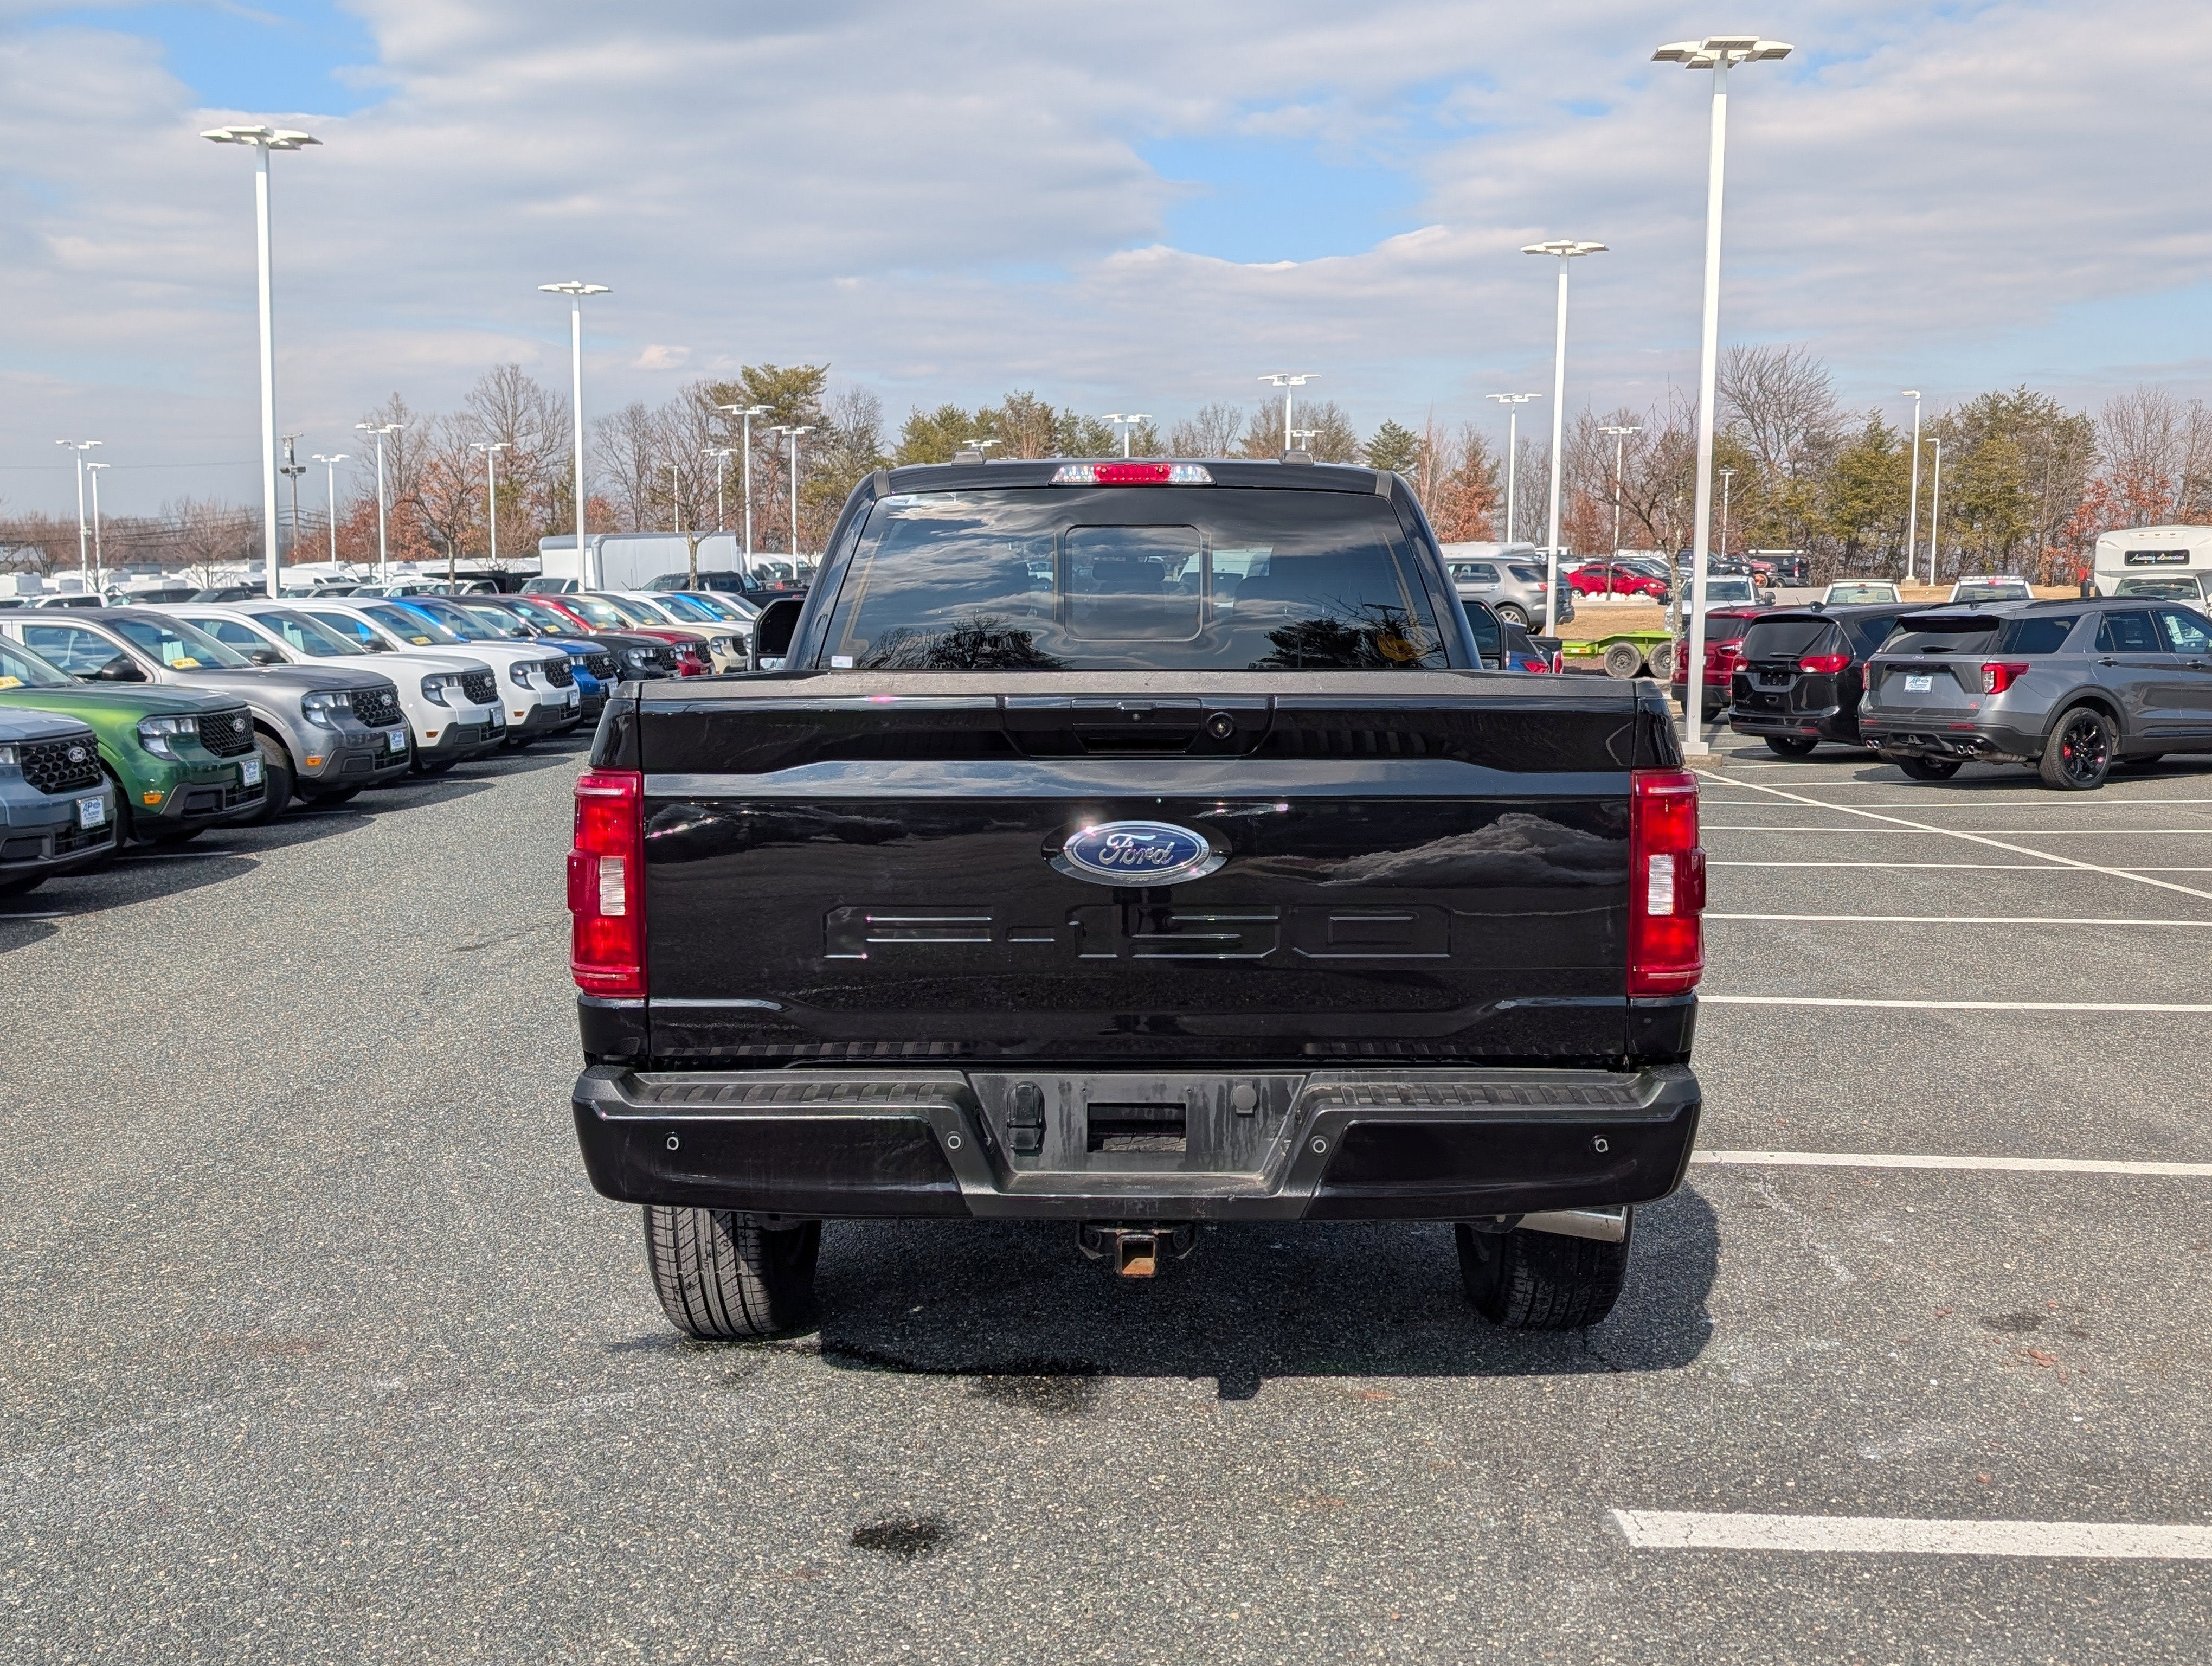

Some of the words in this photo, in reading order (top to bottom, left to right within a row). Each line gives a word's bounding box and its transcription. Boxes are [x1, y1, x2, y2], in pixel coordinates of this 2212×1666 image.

[82, 802, 92, 813] AP
[1098, 832, 1175, 865] Ford
[823, 904, 1452, 959] F-150
